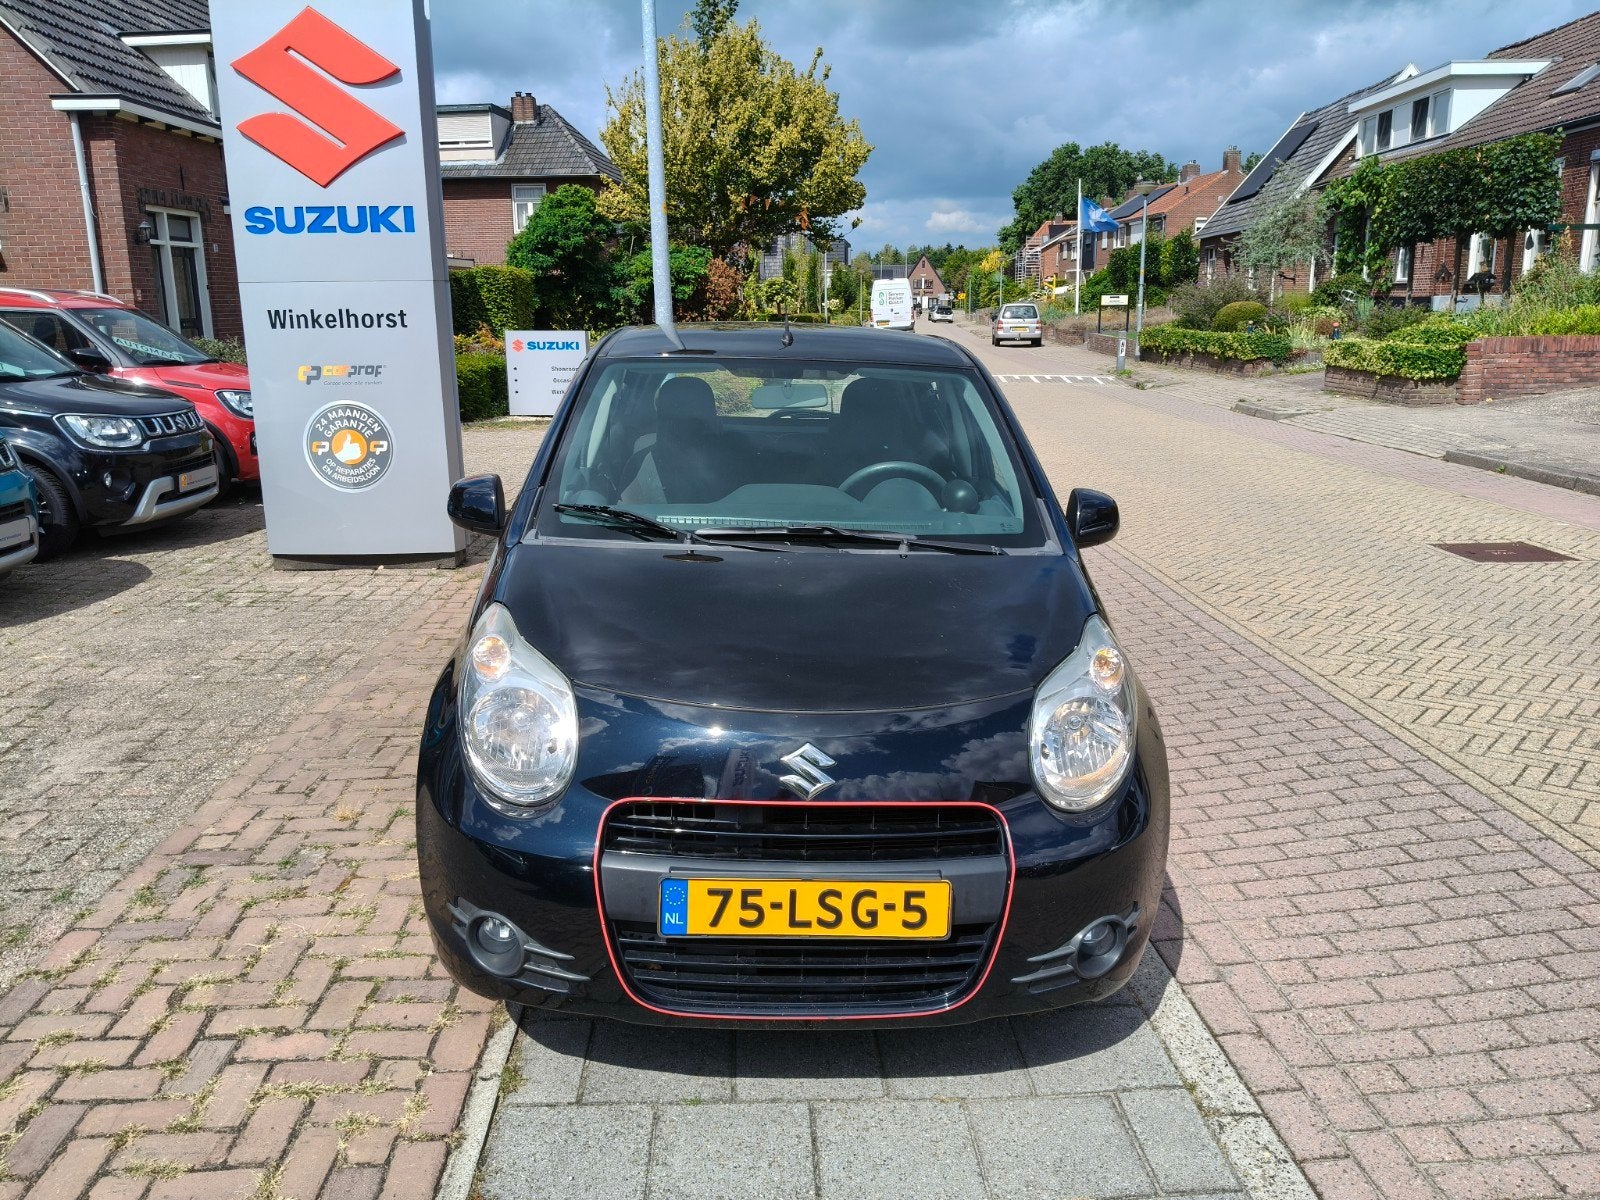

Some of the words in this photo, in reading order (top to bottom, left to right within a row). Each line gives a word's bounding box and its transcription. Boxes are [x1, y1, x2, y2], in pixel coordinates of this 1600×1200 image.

[244, 205, 416, 235] SUZUKI
[267, 308, 408, 330] Winkelhorst
[527, 341, 580, 351] SUZUKI
[316, 418, 328, 432] 24
[327, 408, 381, 432] MAANDEN
[324, 419, 374, 438] GARANTIE
[322, 464, 333, 475] EN
[332, 465, 381, 484] ARBEIDSLOON
[326, 458, 337, 468] OP
[335, 457, 376, 476] REPARATIES
[665, 912, 684, 925] NL
[707, 888, 928, 930] 75-LSG-5
